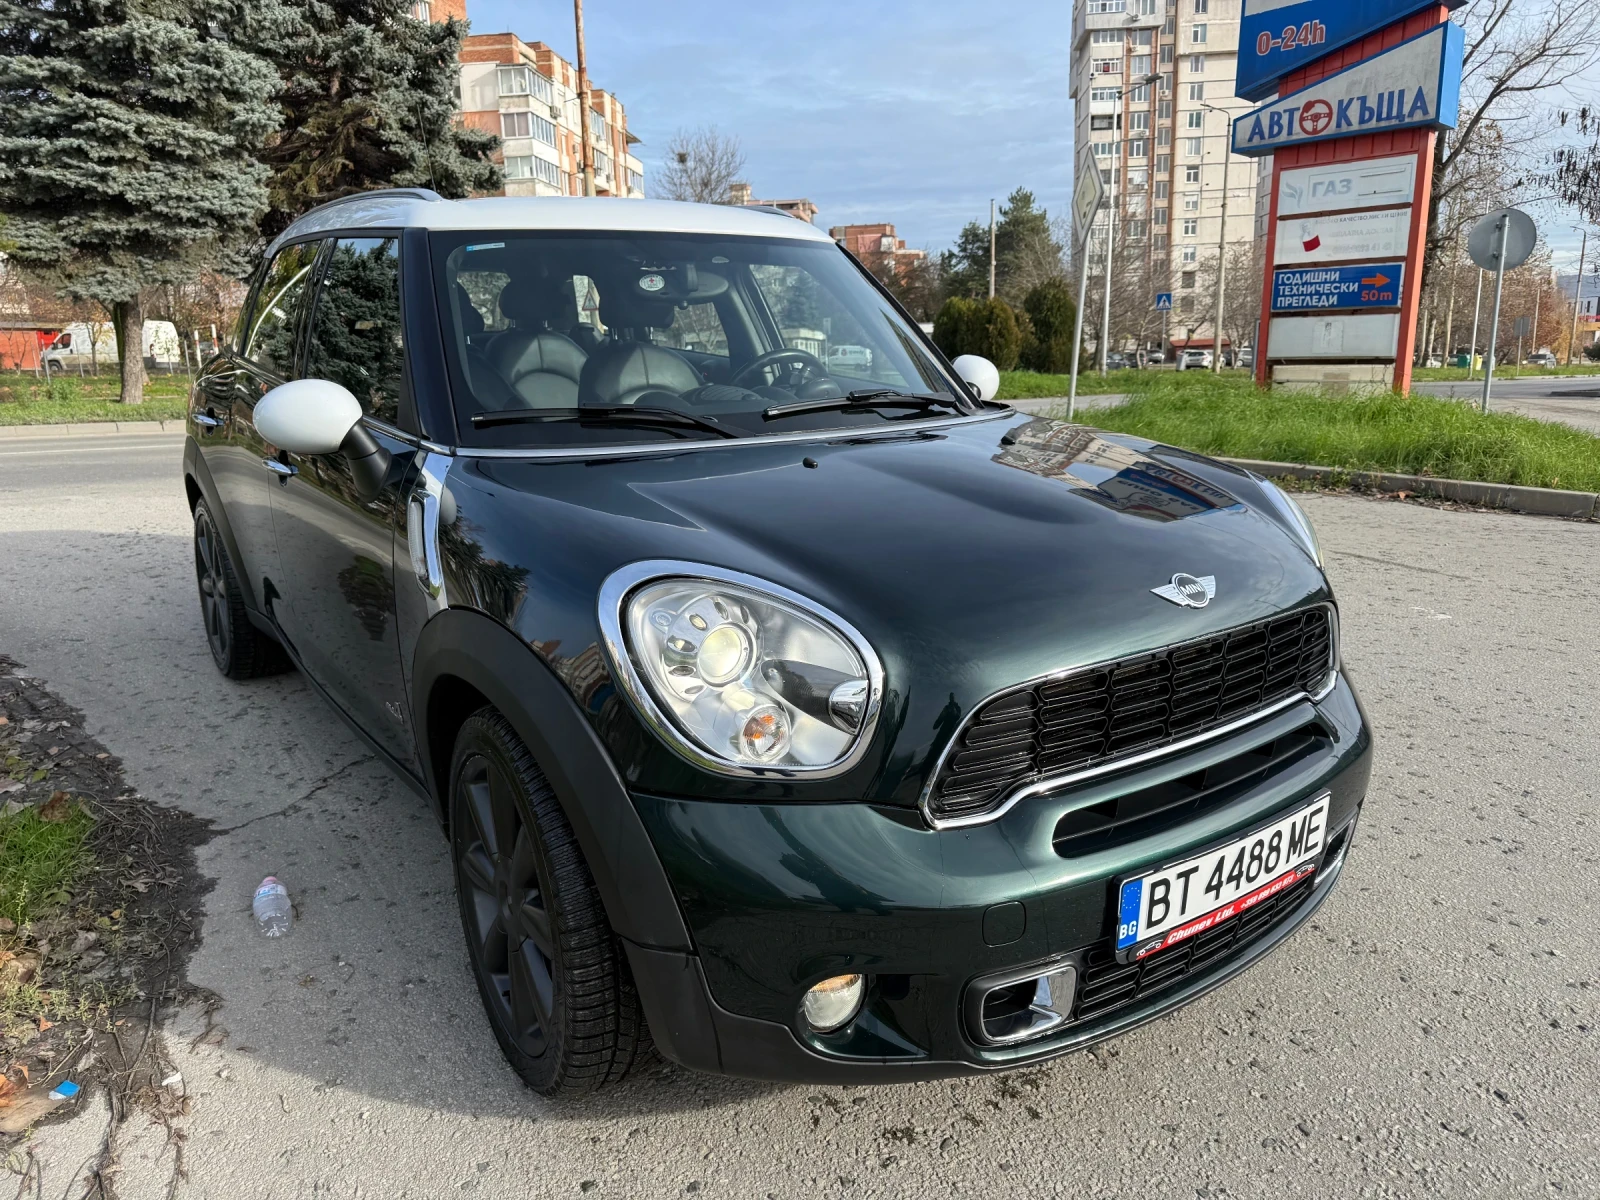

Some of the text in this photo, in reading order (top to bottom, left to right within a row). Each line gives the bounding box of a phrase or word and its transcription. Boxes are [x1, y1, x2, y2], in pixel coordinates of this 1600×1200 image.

[1256, 20, 1326, 56] 0-24h
[1311, 178, 1352, 198] ГАЗ
[1278, 271, 1340, 285] ГОДИШНИ
[1278, 282, 1359, 296] ТЕХНИЧЕСКИ
[1277, 295, 1338, 307] ПРЕГЛЕДИ
[1180, 583, 1205, 595] MINI
[1119, 921, 1137, 939] BG
[1145, 865, 1200, 930] BT
[1204, 830, 1283, 901] 4488
[1285, 805, 1324, 865] ME
[1167, 918, 1213, 944] Chunev
[1214, 906, 1235, 923] Ltd.
